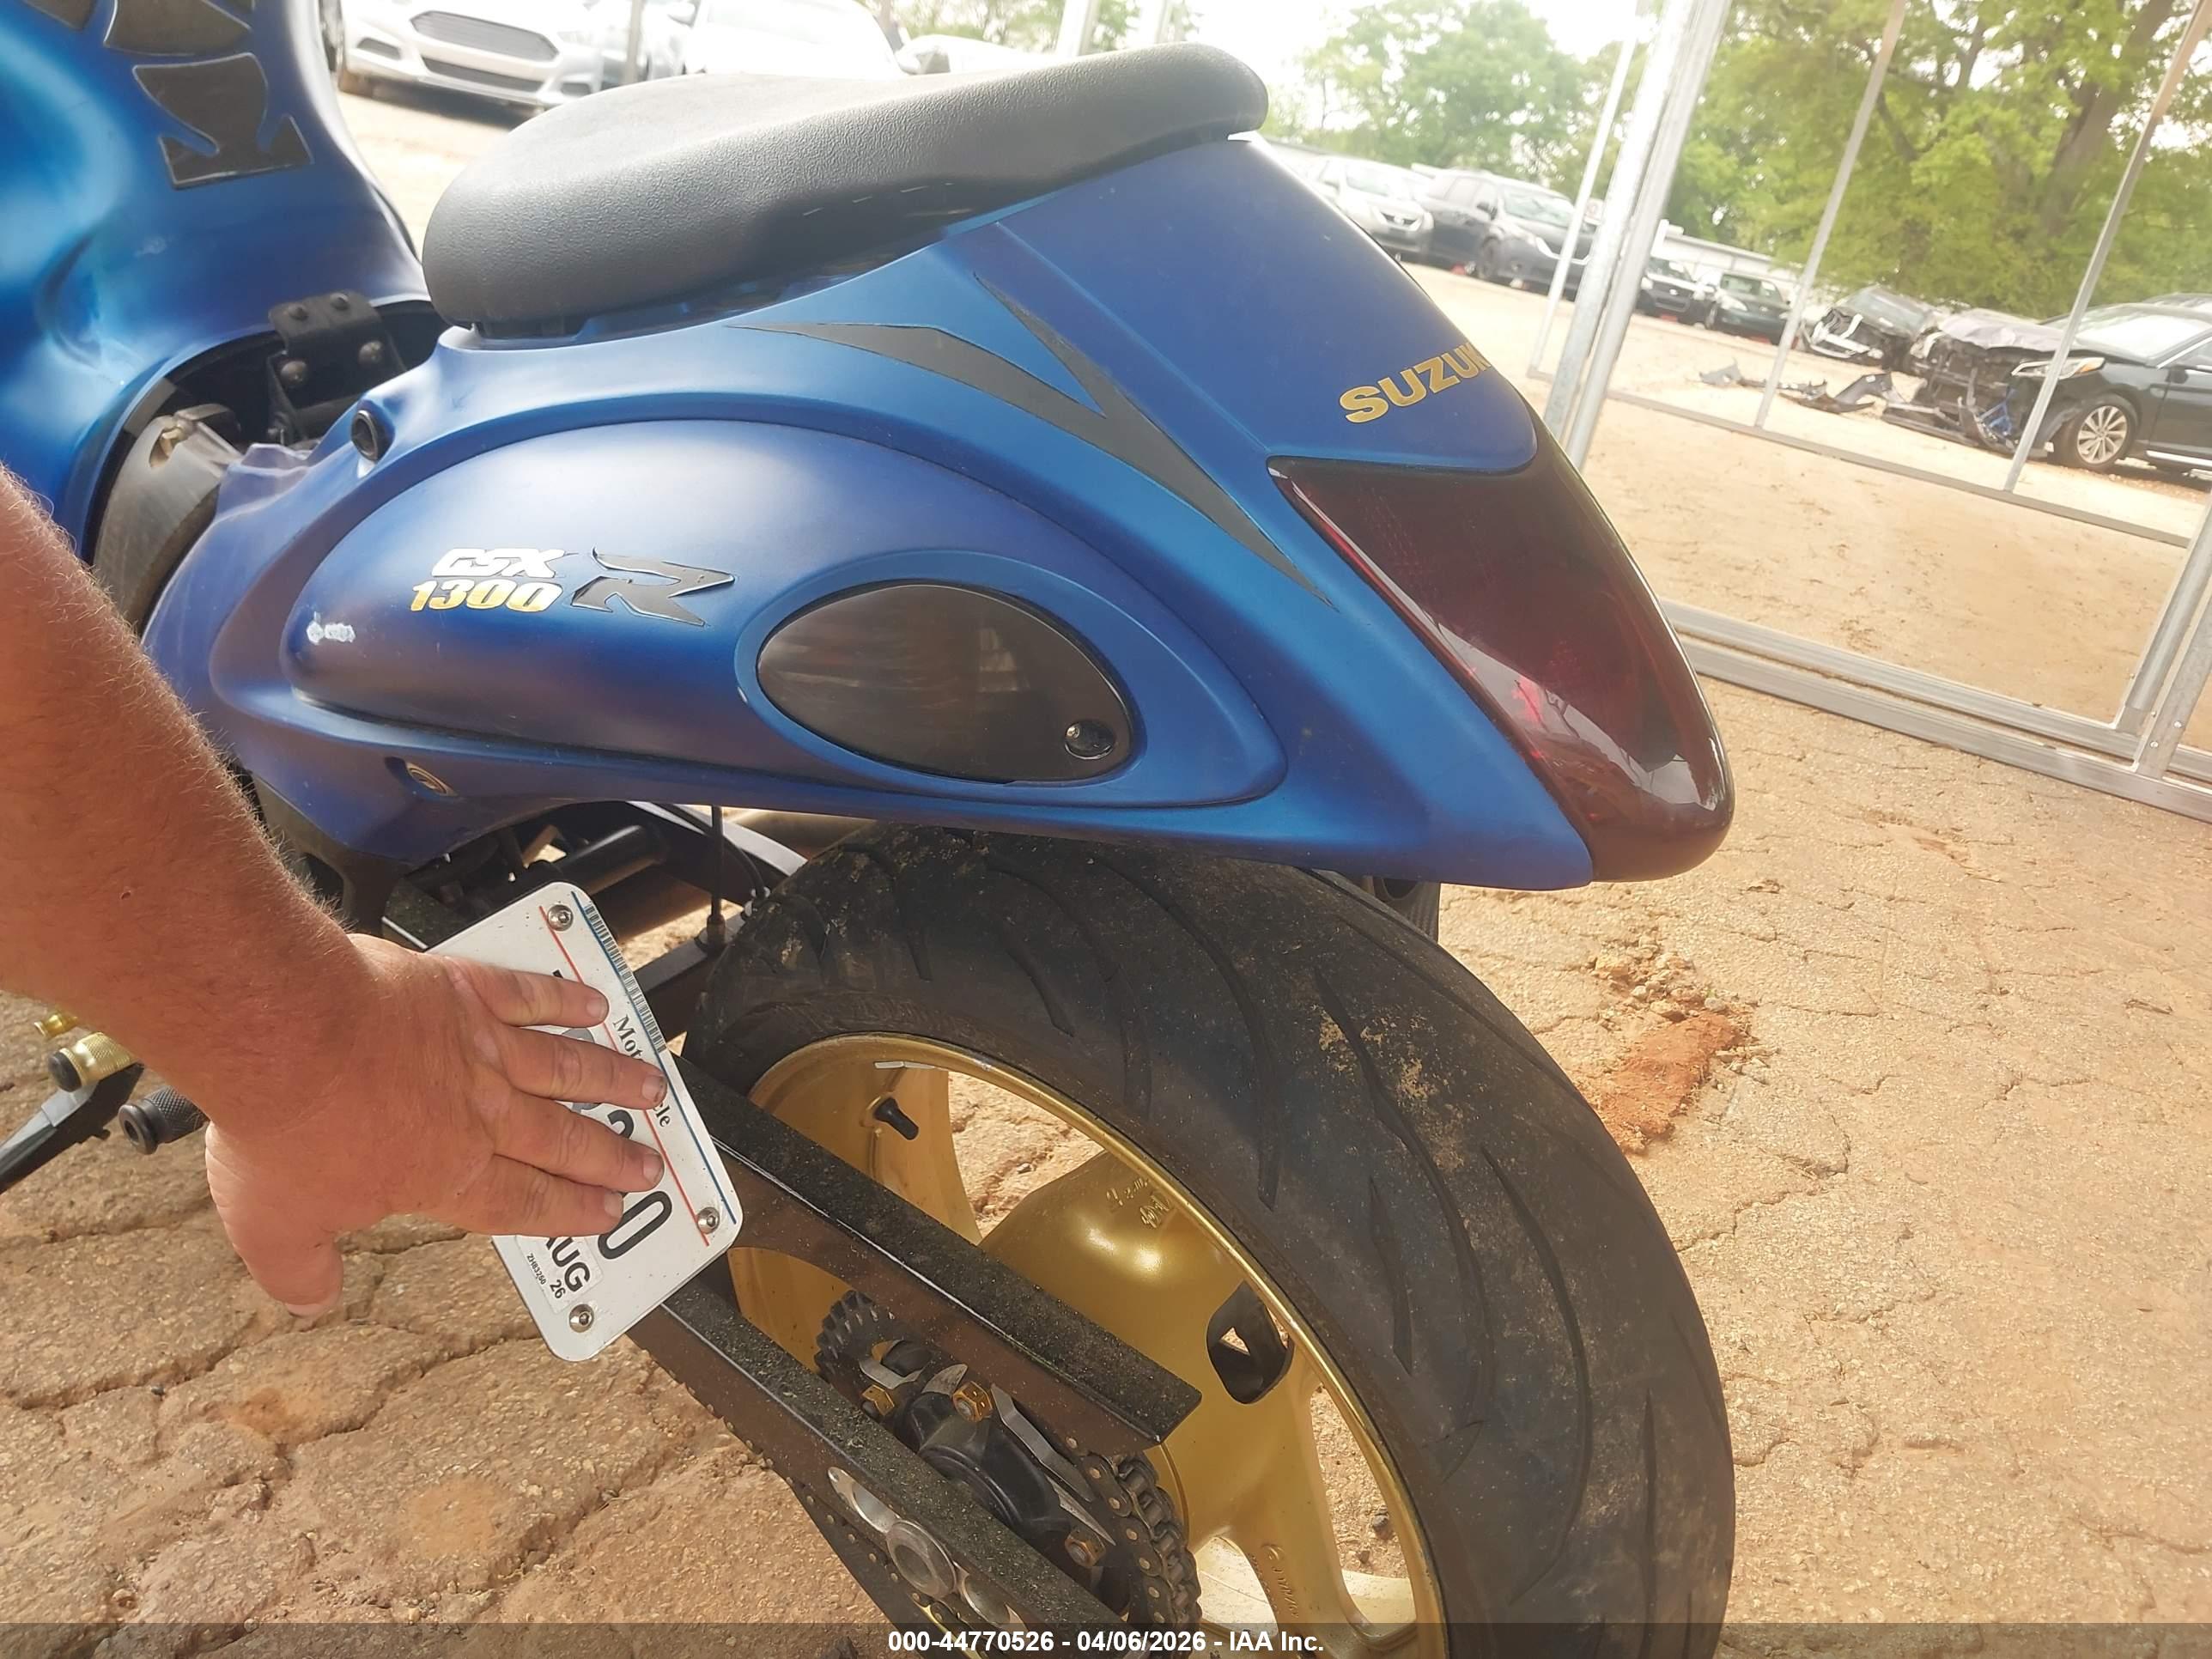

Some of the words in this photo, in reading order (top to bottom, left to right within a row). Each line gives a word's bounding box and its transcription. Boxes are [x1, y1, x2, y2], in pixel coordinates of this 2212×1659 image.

[431, 548, 565, 578] GSX
[410, 579, 563, 612] 1300
[550, 1279, 566, 1299] 26
